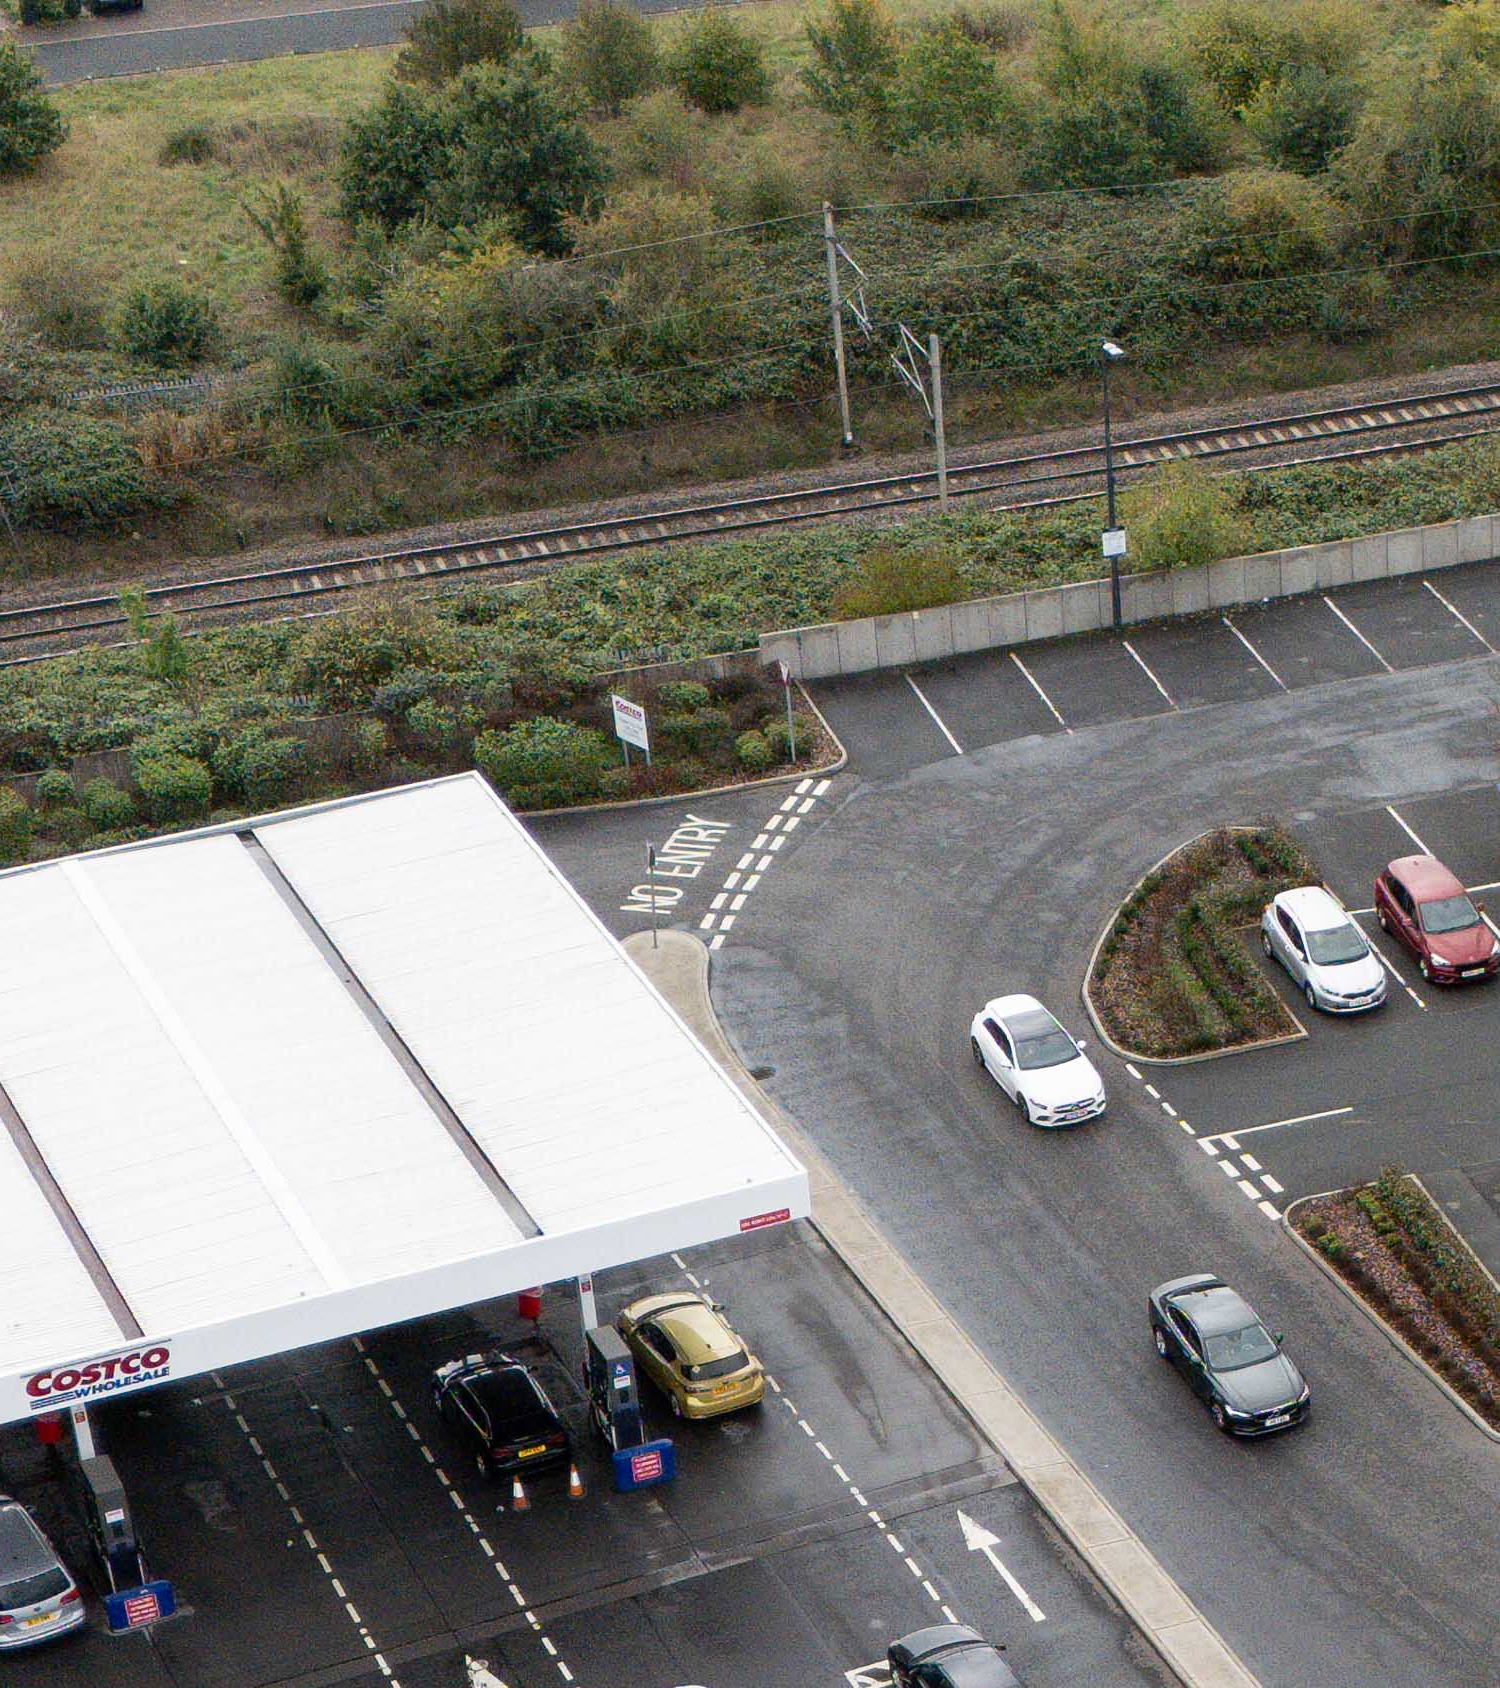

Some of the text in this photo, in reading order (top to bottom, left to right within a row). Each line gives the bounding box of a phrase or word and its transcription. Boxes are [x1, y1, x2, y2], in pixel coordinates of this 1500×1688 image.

[620, 814, 731, 914] NO ENTRY
[26, 1347, 170, 1397] COSTCO
[75, 1367, 169, 1398] WHOLESALE
